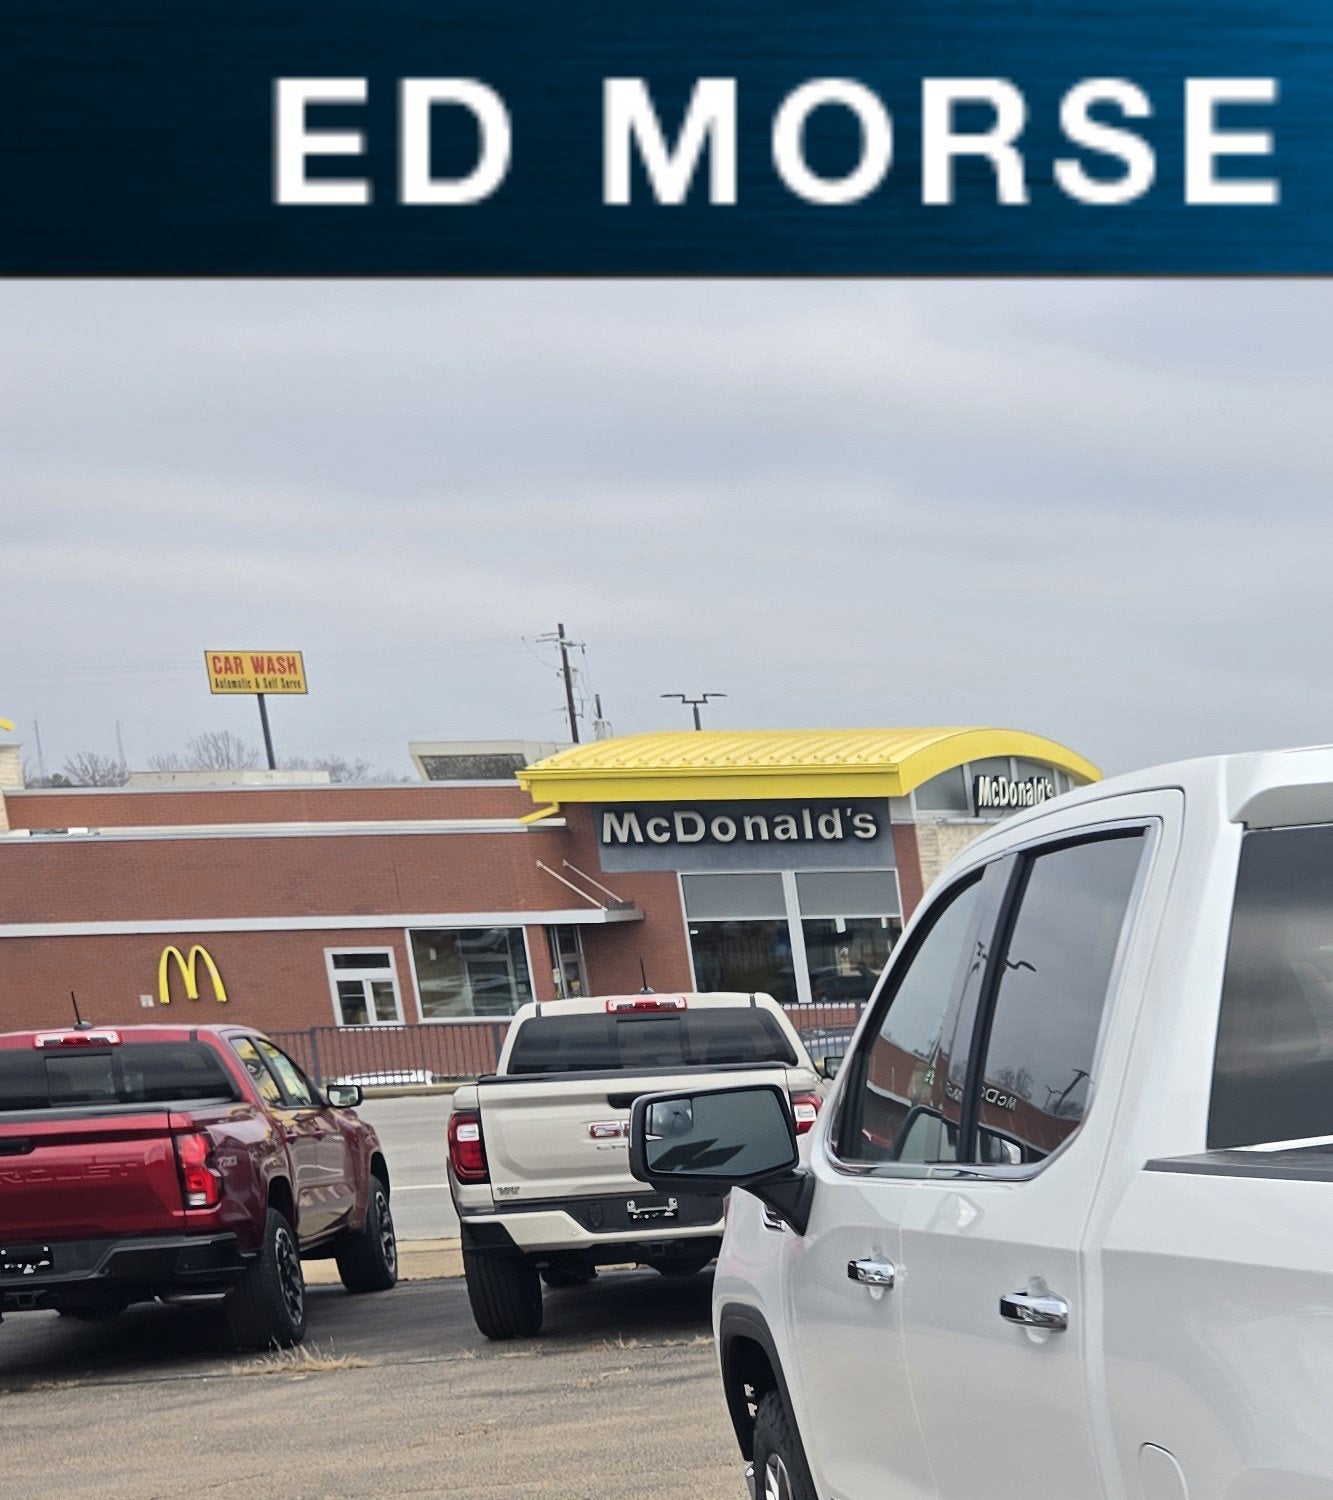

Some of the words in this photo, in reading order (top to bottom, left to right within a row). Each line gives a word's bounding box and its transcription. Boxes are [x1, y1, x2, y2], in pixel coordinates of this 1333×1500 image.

[212, 655, 244, 674] CAR
[250, 655, 298, 675] WASH
[214, 677, 252, 689] Automatic
[977, 775, 1054, 807] McDonald's
[602, 807, 878, 844] McDonald's
